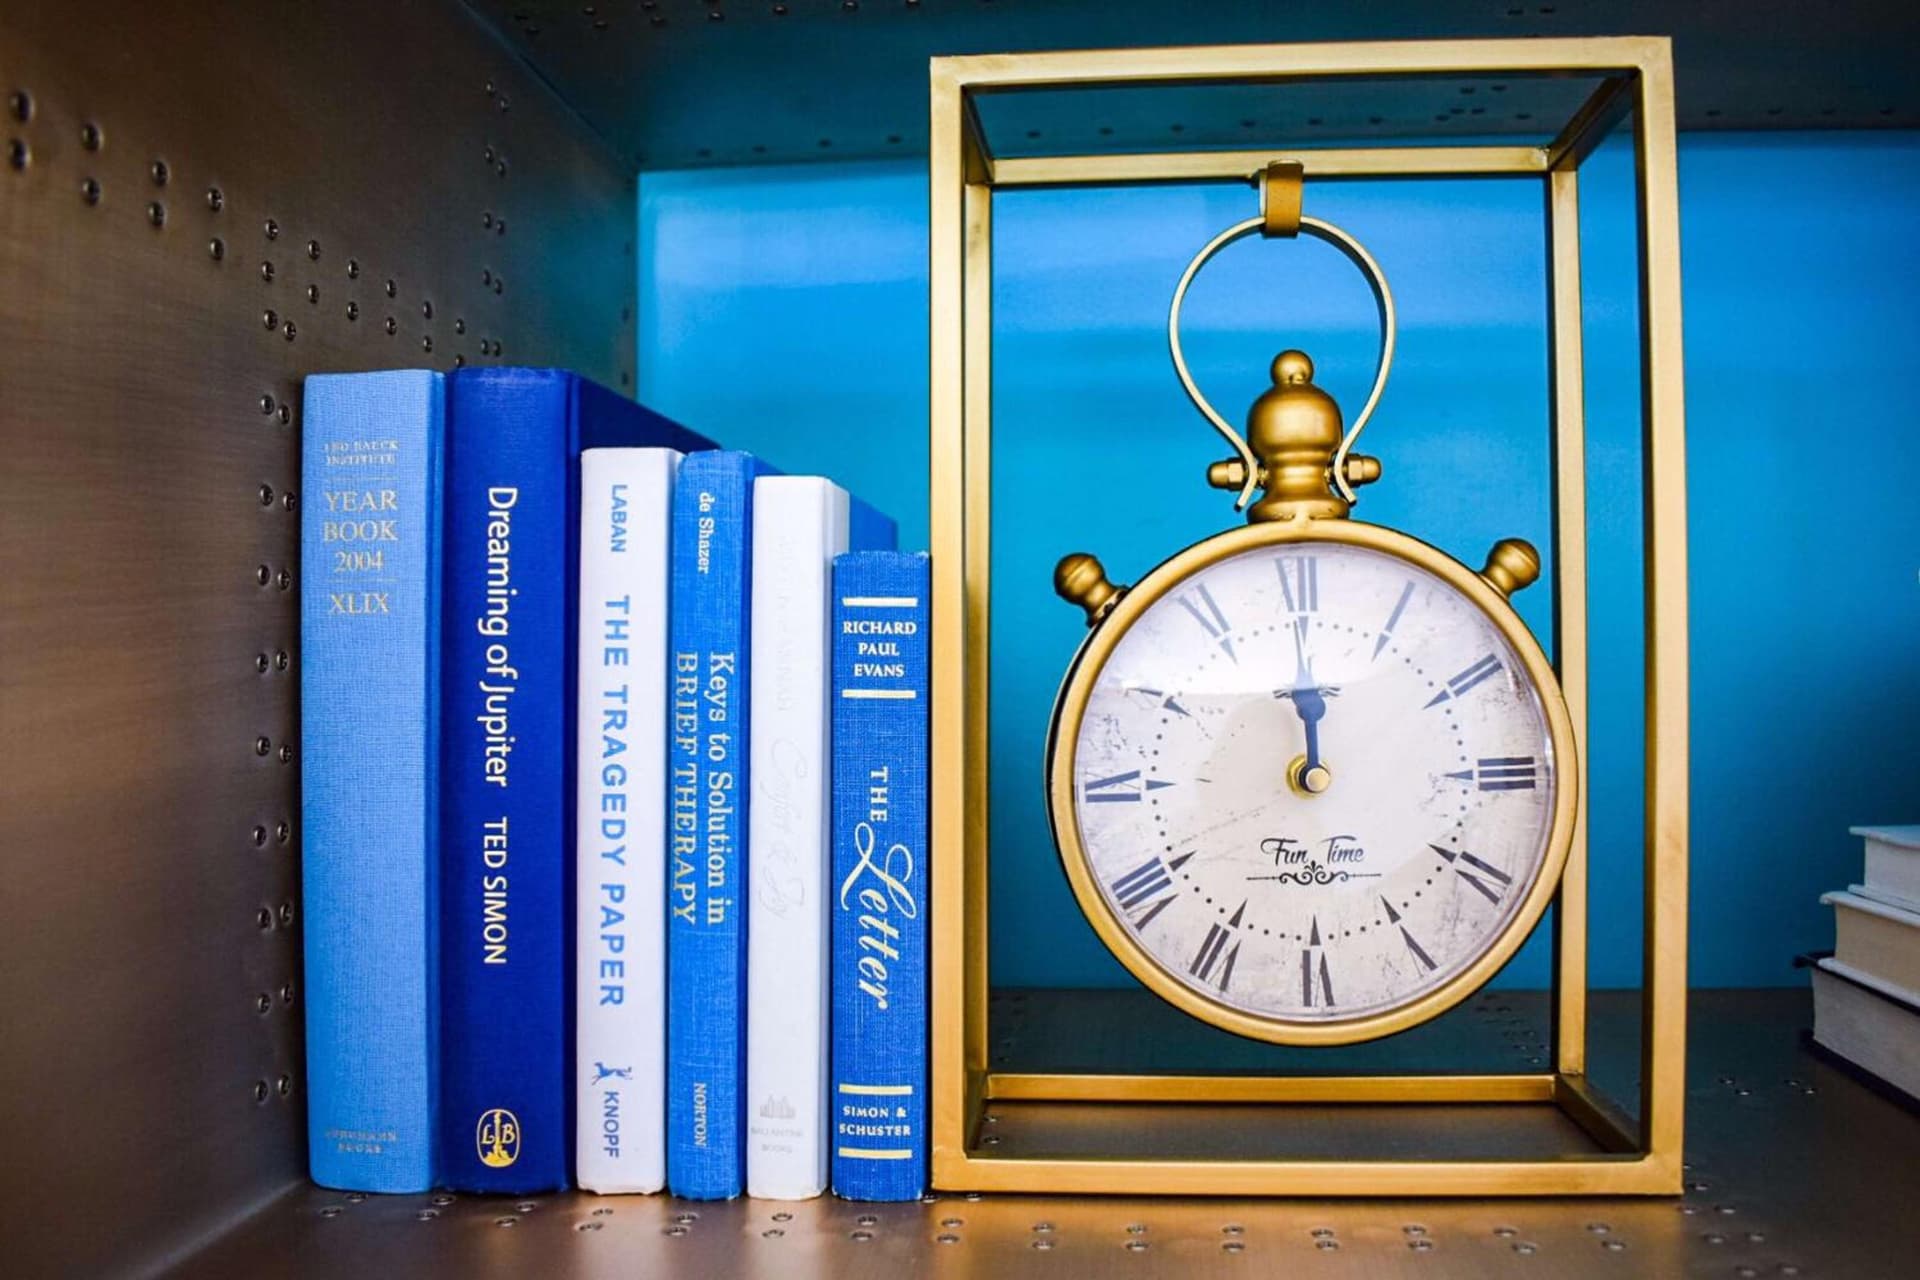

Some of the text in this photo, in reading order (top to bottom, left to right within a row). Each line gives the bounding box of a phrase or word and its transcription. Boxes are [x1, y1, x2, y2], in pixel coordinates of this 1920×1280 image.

[325, 489, 399, 512] YEAR
[611, 485, 628, 552] LABAN
[324, 519, 398, 542] BOOK
[698, 492, 715, 574] de Shazer
[334, 551, 384, 572] 2004
[330, 592, 390, 614] XLIX
[477, 487, 518, 787] Dreaming of Jupiter
[843, 621, 917, 635] RICHARD
[858, 643, 899, 657] PAUL
[854, 664, 904, 678] EVANS
[673, 653, 698, 925] BRIEF THERAPY
[704, 653, 735, 925] Keys to Solution in
[870, 766, 888, 822] THE
[1477, 756, 1536, 791] III
[600, 595, 630, 1006] THE TRAGEDY PAPER
[1260, 835, 1364, 866] Fun Time
[483, 817, 507, 964] TED SIMON
[841, 822, 916, 1009] Letter
[602, 1092, 620, 1158] KNOPF
[692, 1083, 707, 1146] NORTON
[839, 1123, 911, 1136] SCHUSTER
[843, 1106, 907, 1118] SIMON &
